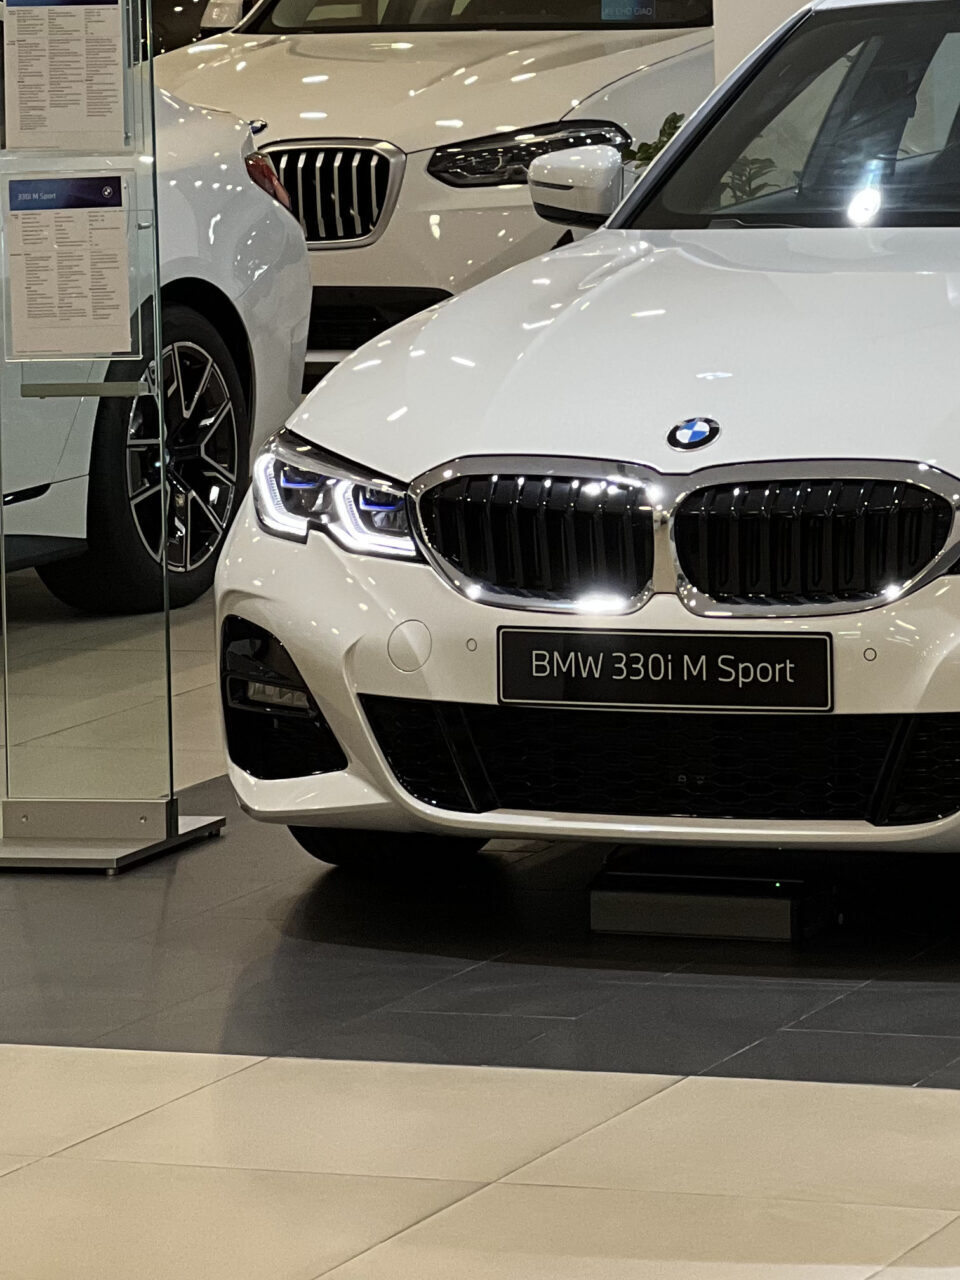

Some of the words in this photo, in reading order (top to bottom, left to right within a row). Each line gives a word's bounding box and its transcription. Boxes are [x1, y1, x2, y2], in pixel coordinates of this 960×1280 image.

[39, 192, 56, 201] Sport
[531, 650, 604, 678] BMW
[611, 652, 672, 680] 330i
[683, 655, 707, 681] M
[717, 655, 795, 688] Sport
